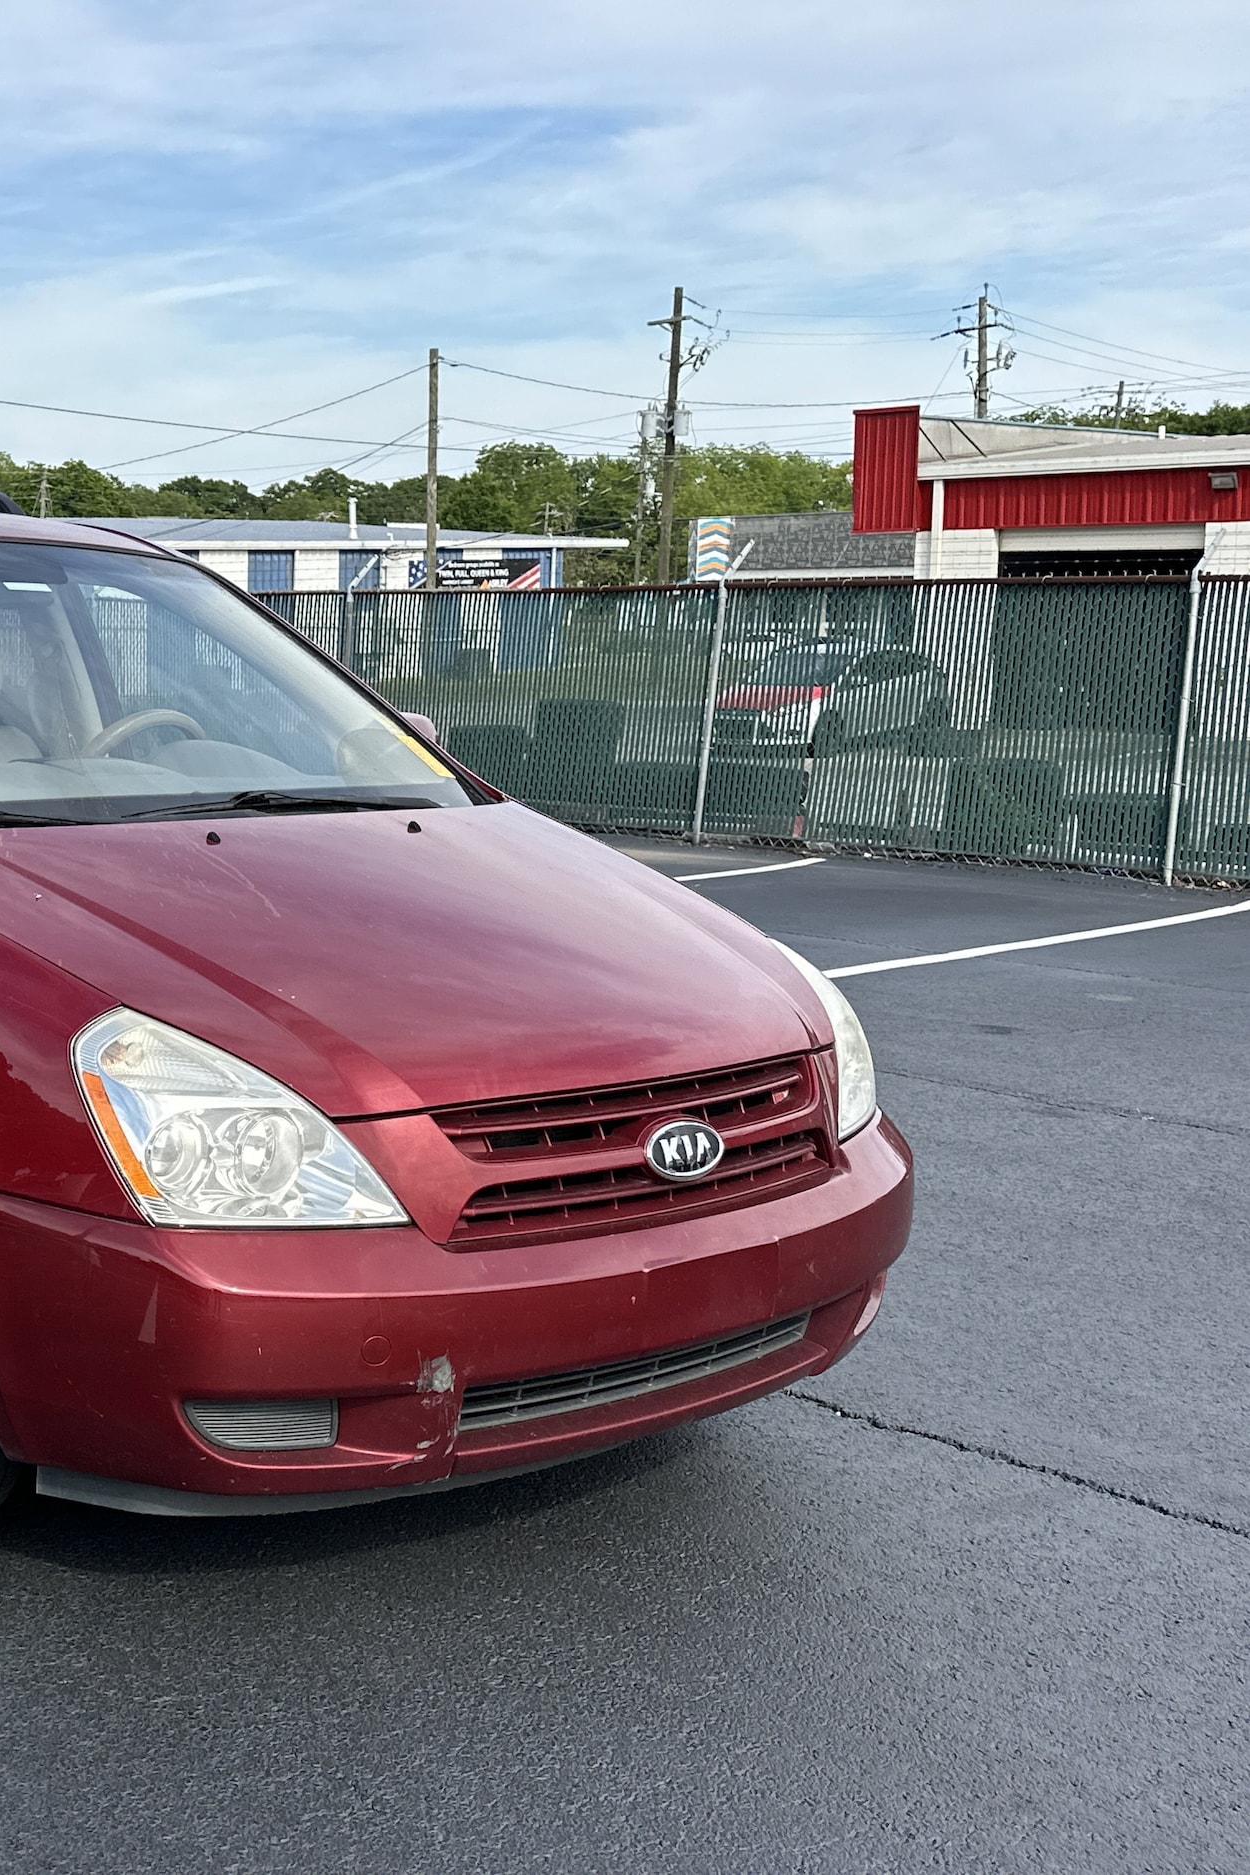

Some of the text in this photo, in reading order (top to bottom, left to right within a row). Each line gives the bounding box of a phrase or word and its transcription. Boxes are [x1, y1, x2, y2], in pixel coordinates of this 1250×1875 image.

[470, 569, 489, 578] QUEEN
[495, 568, 509, 577] KING
[658, 1132, 711, 1167] KIA
